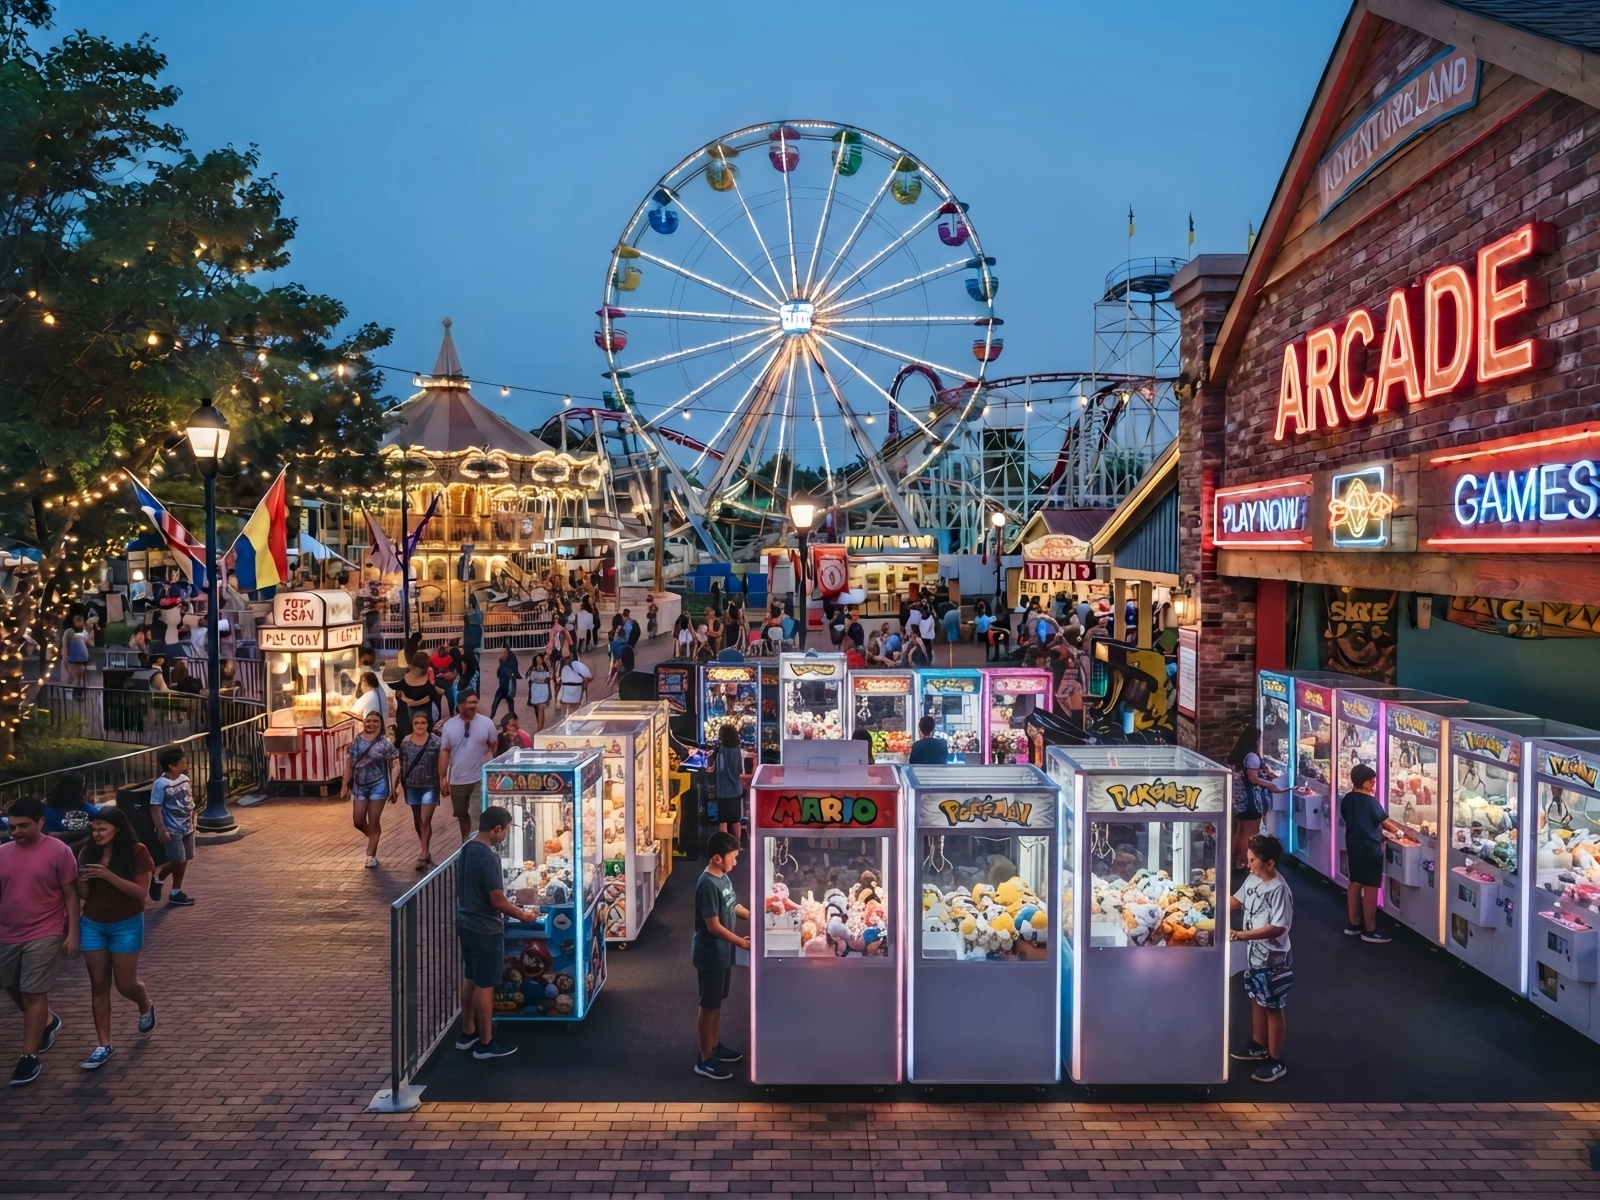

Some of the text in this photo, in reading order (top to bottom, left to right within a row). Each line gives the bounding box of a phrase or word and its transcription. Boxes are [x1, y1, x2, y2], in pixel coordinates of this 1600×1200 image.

[1274, 225, 1534, 441] ARCADE
[1455, 460, 1598, 525] GAMES
[772, 795, 877, 825] MARIO
